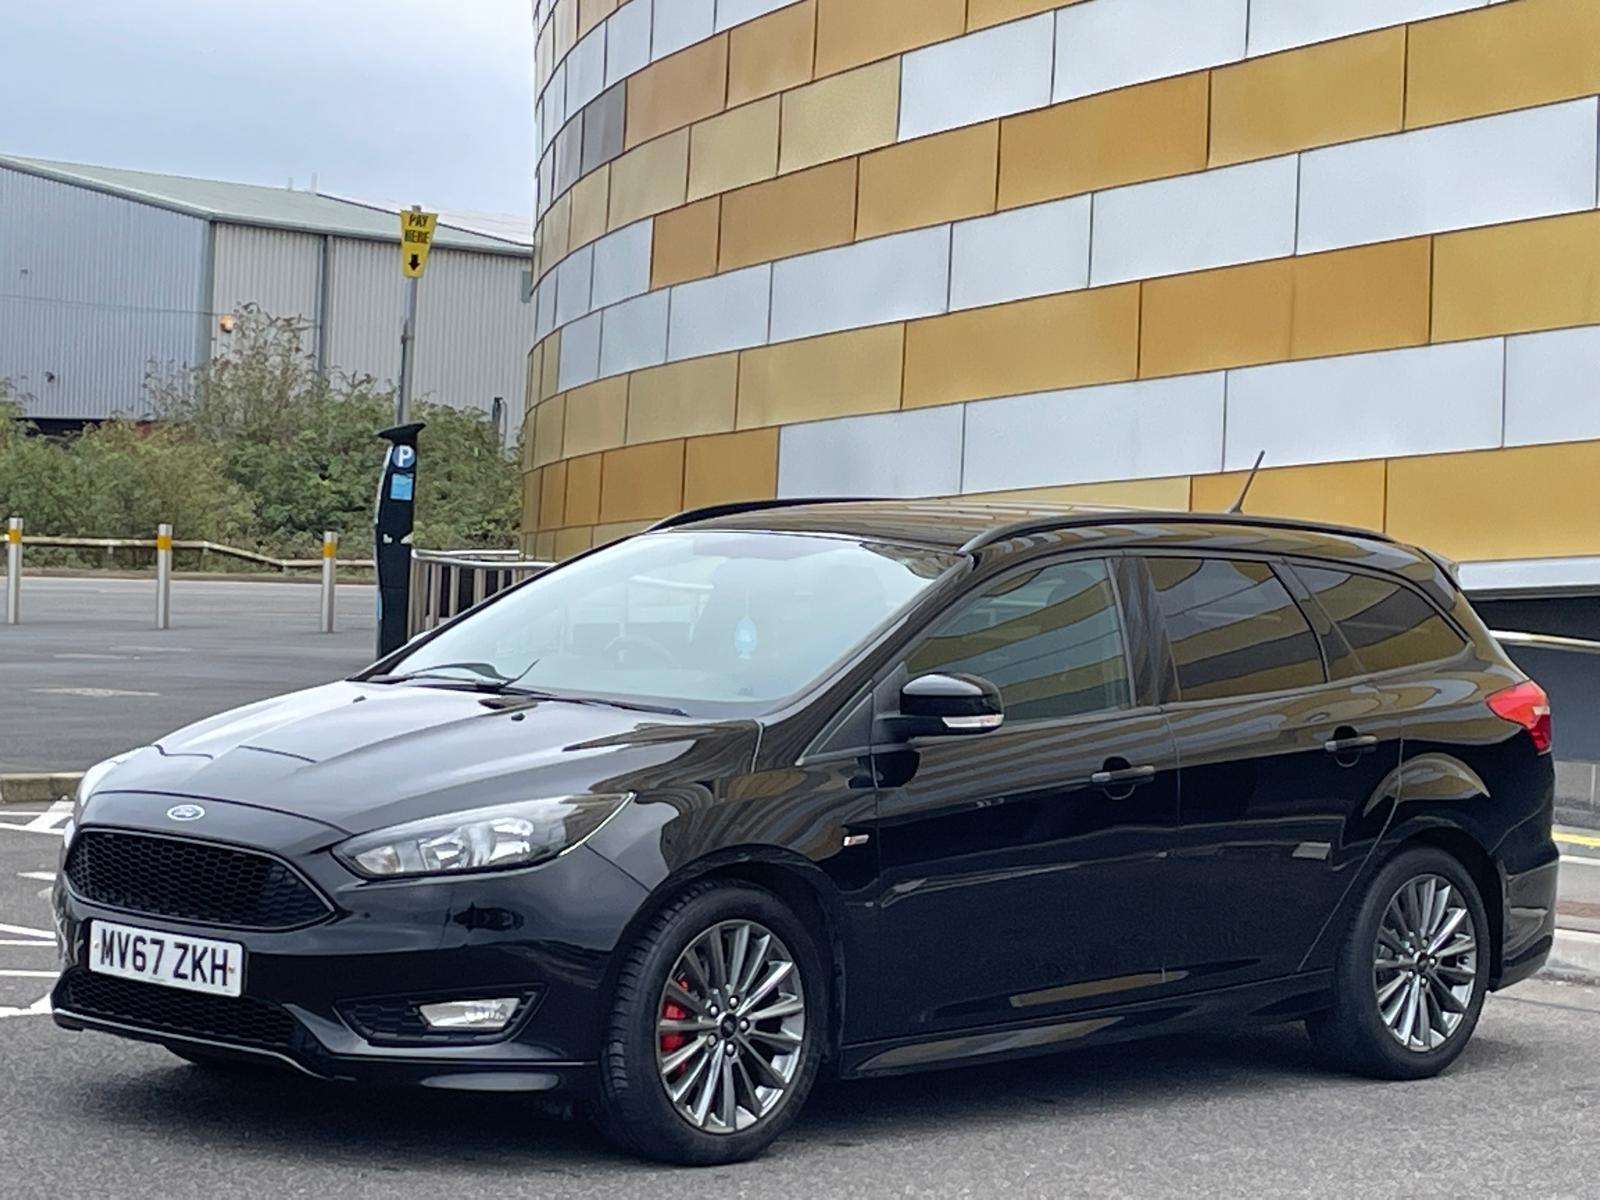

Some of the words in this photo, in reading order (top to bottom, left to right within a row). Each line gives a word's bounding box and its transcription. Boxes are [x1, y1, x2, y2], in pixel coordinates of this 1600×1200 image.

[409, 214, 429, 228] PAY
[404, 229, 430, 244] HERE
[399, 444, 412, 468] P
[101, 928, 165, 976] MV67
[173, 941, 228, 987] ZKH
